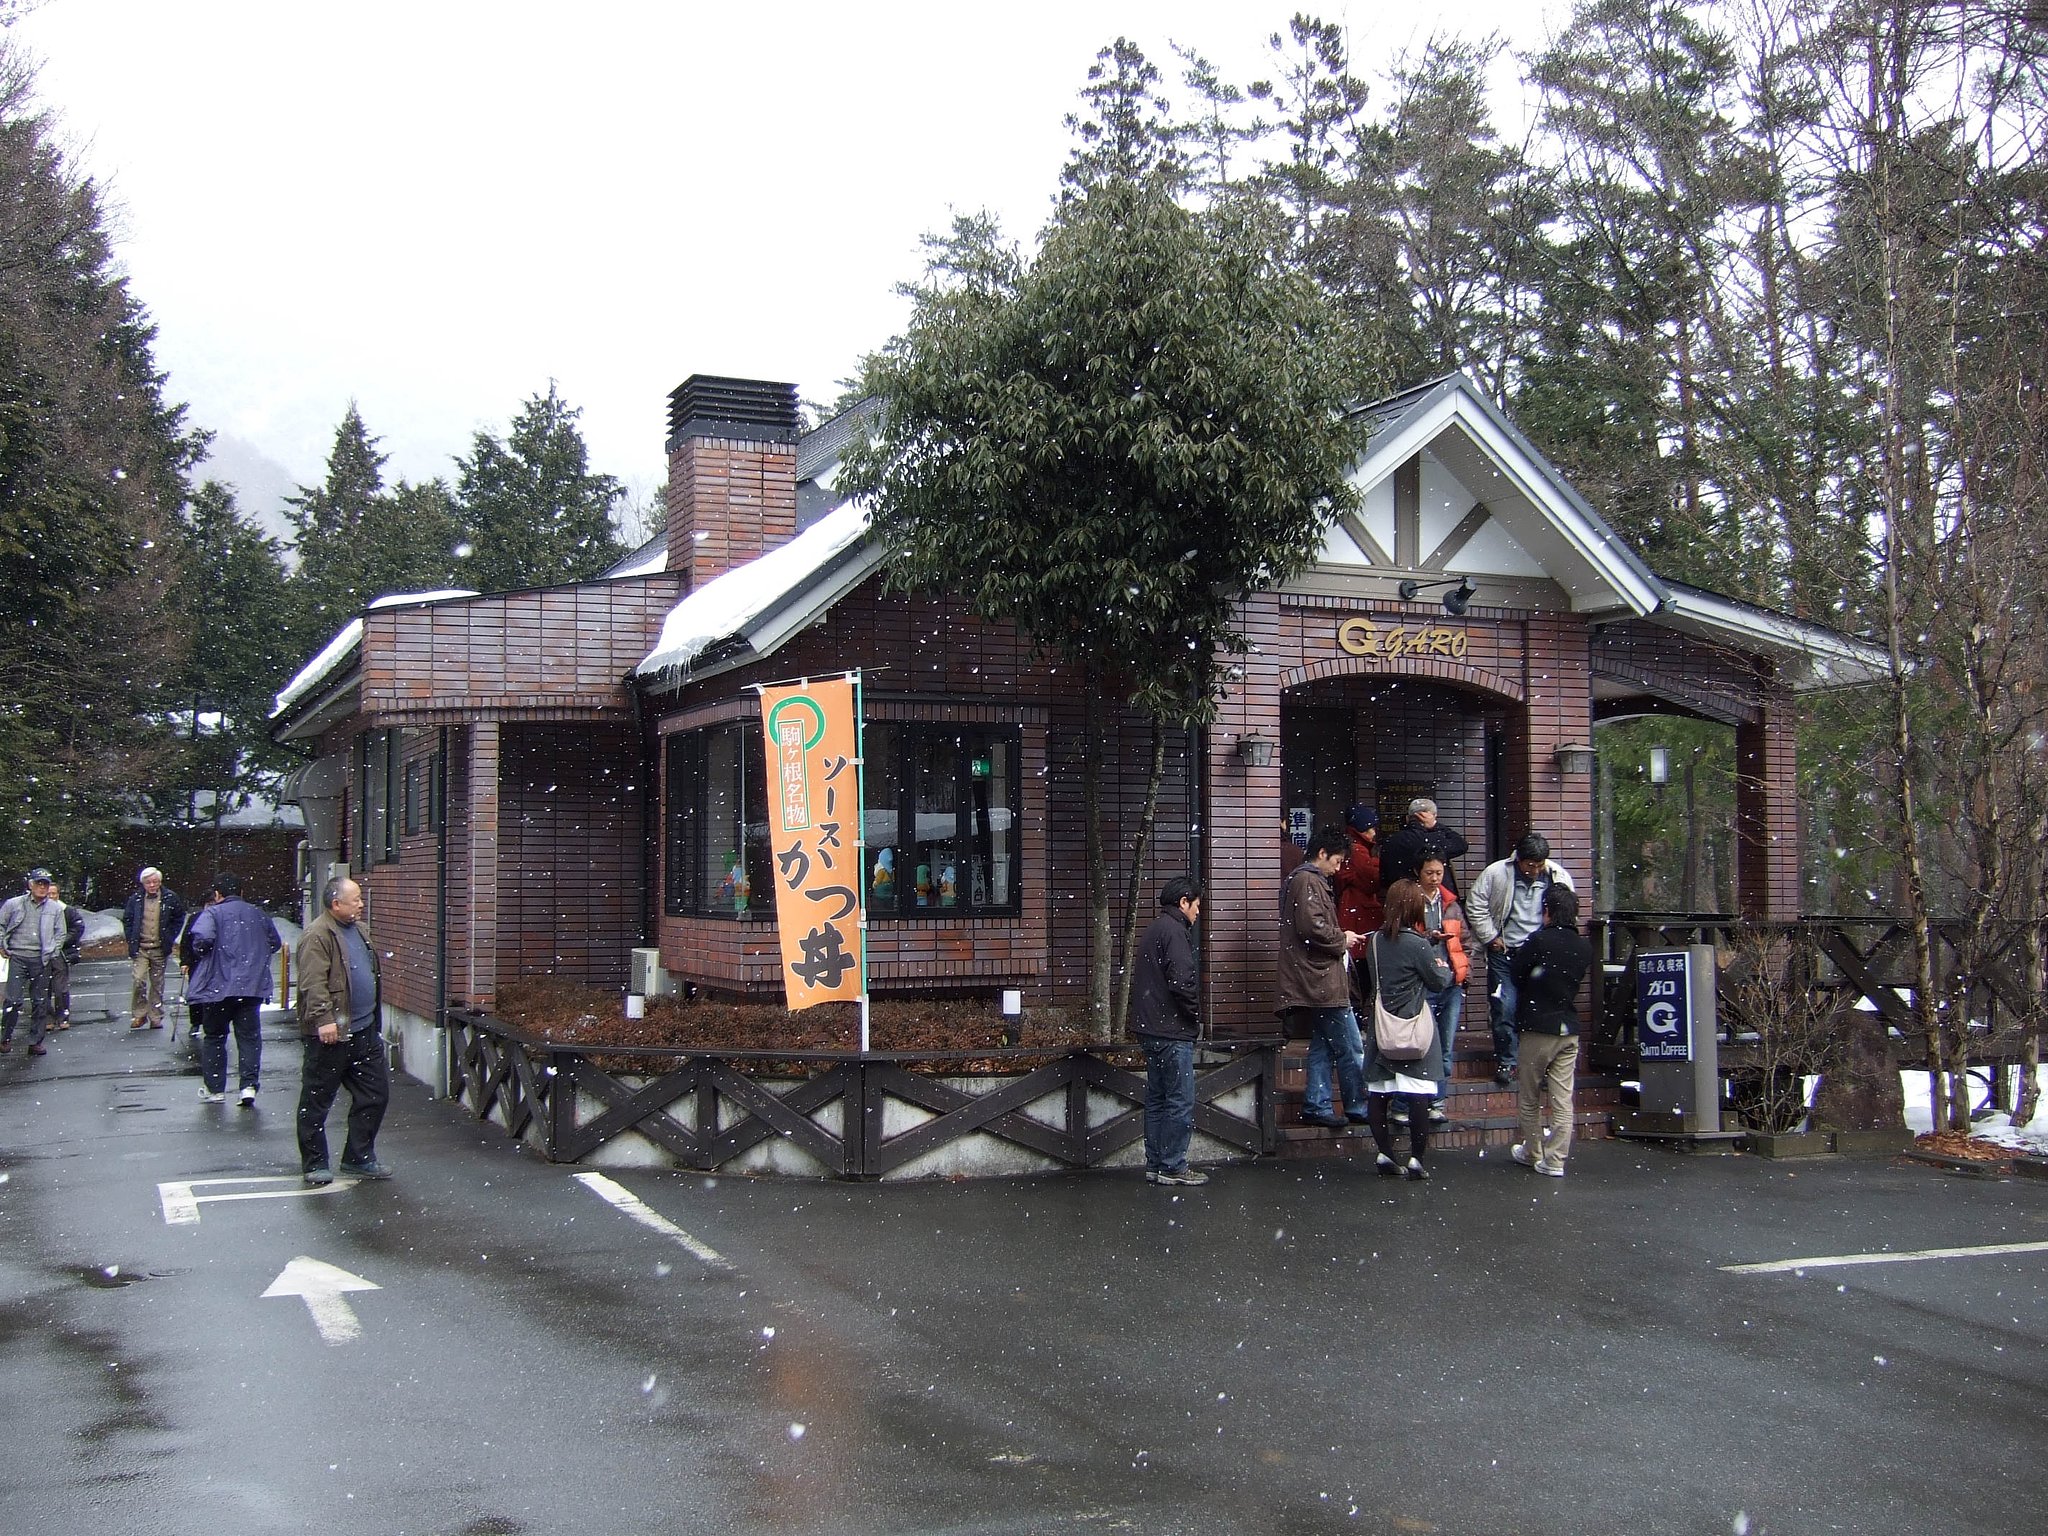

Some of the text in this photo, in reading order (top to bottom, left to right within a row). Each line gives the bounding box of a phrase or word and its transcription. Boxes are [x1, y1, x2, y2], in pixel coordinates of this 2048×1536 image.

[1384, 628, 1467, 661] GARO
[1656, 959, 1666, 972] &
[1647, 980, 1675, 996] ガロ
[1660, 1040, 1687, 1056] COFFEE
